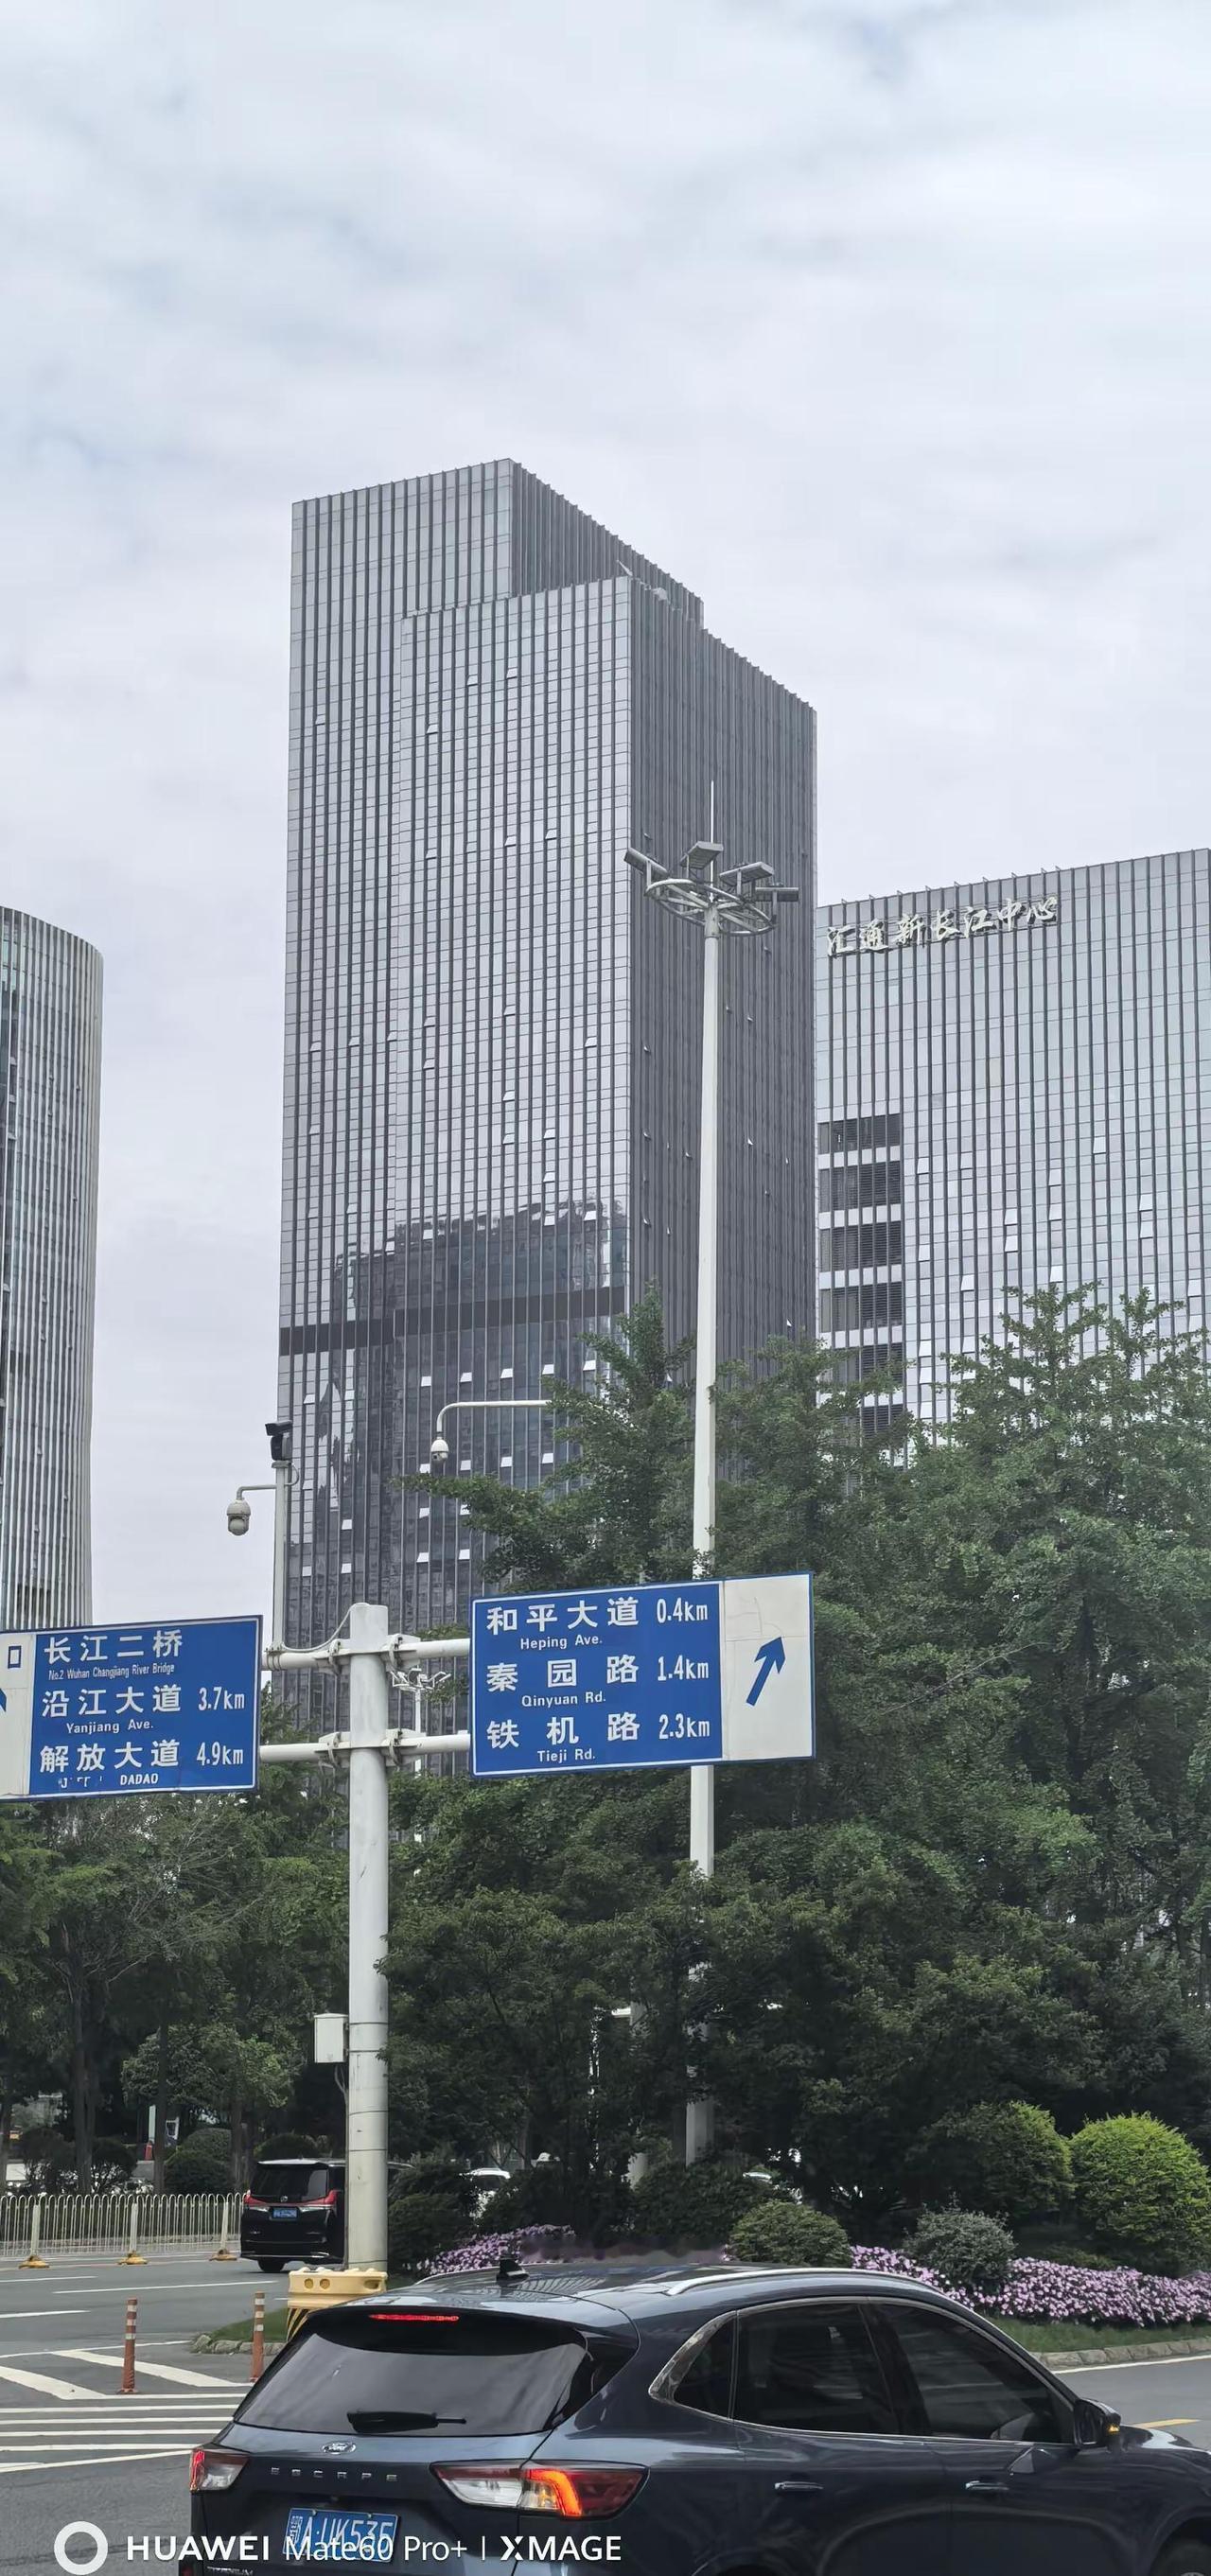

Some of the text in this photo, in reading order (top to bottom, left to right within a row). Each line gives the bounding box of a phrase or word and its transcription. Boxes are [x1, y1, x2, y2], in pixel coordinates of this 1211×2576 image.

[827, 896, 1058, 957] 汇通新长江中心
[486, 1596, 709, 1636] 和平大道 0.4km
[44, 1629, 183, 1665] 长江二桥
[520, 1634, 603, 1651] Heping Ave.
[48, 1662, 175, 1680] No.2 Wuhan Changjiang River Bridge
[486, 1654, 710, 1692] 秦园路 1.4km
[42, 1684, 245, 1718] 沿江大道 3.7km
[521, 1691, 606, 1709] Qinyuan Rd.
[66, 1718, 154, 1735] Yanjiang Ave.
[486, 1711, 711, 1749] 铁机路 2.3km
[40, 1739, 244, 1773] 解放大道 4.9km
[536, 1747, 596, 1763] Tieji Rd.
[119, 1773, 159, 1786] DADAO
[271, 2467, 398, 2482] ESCAPE
